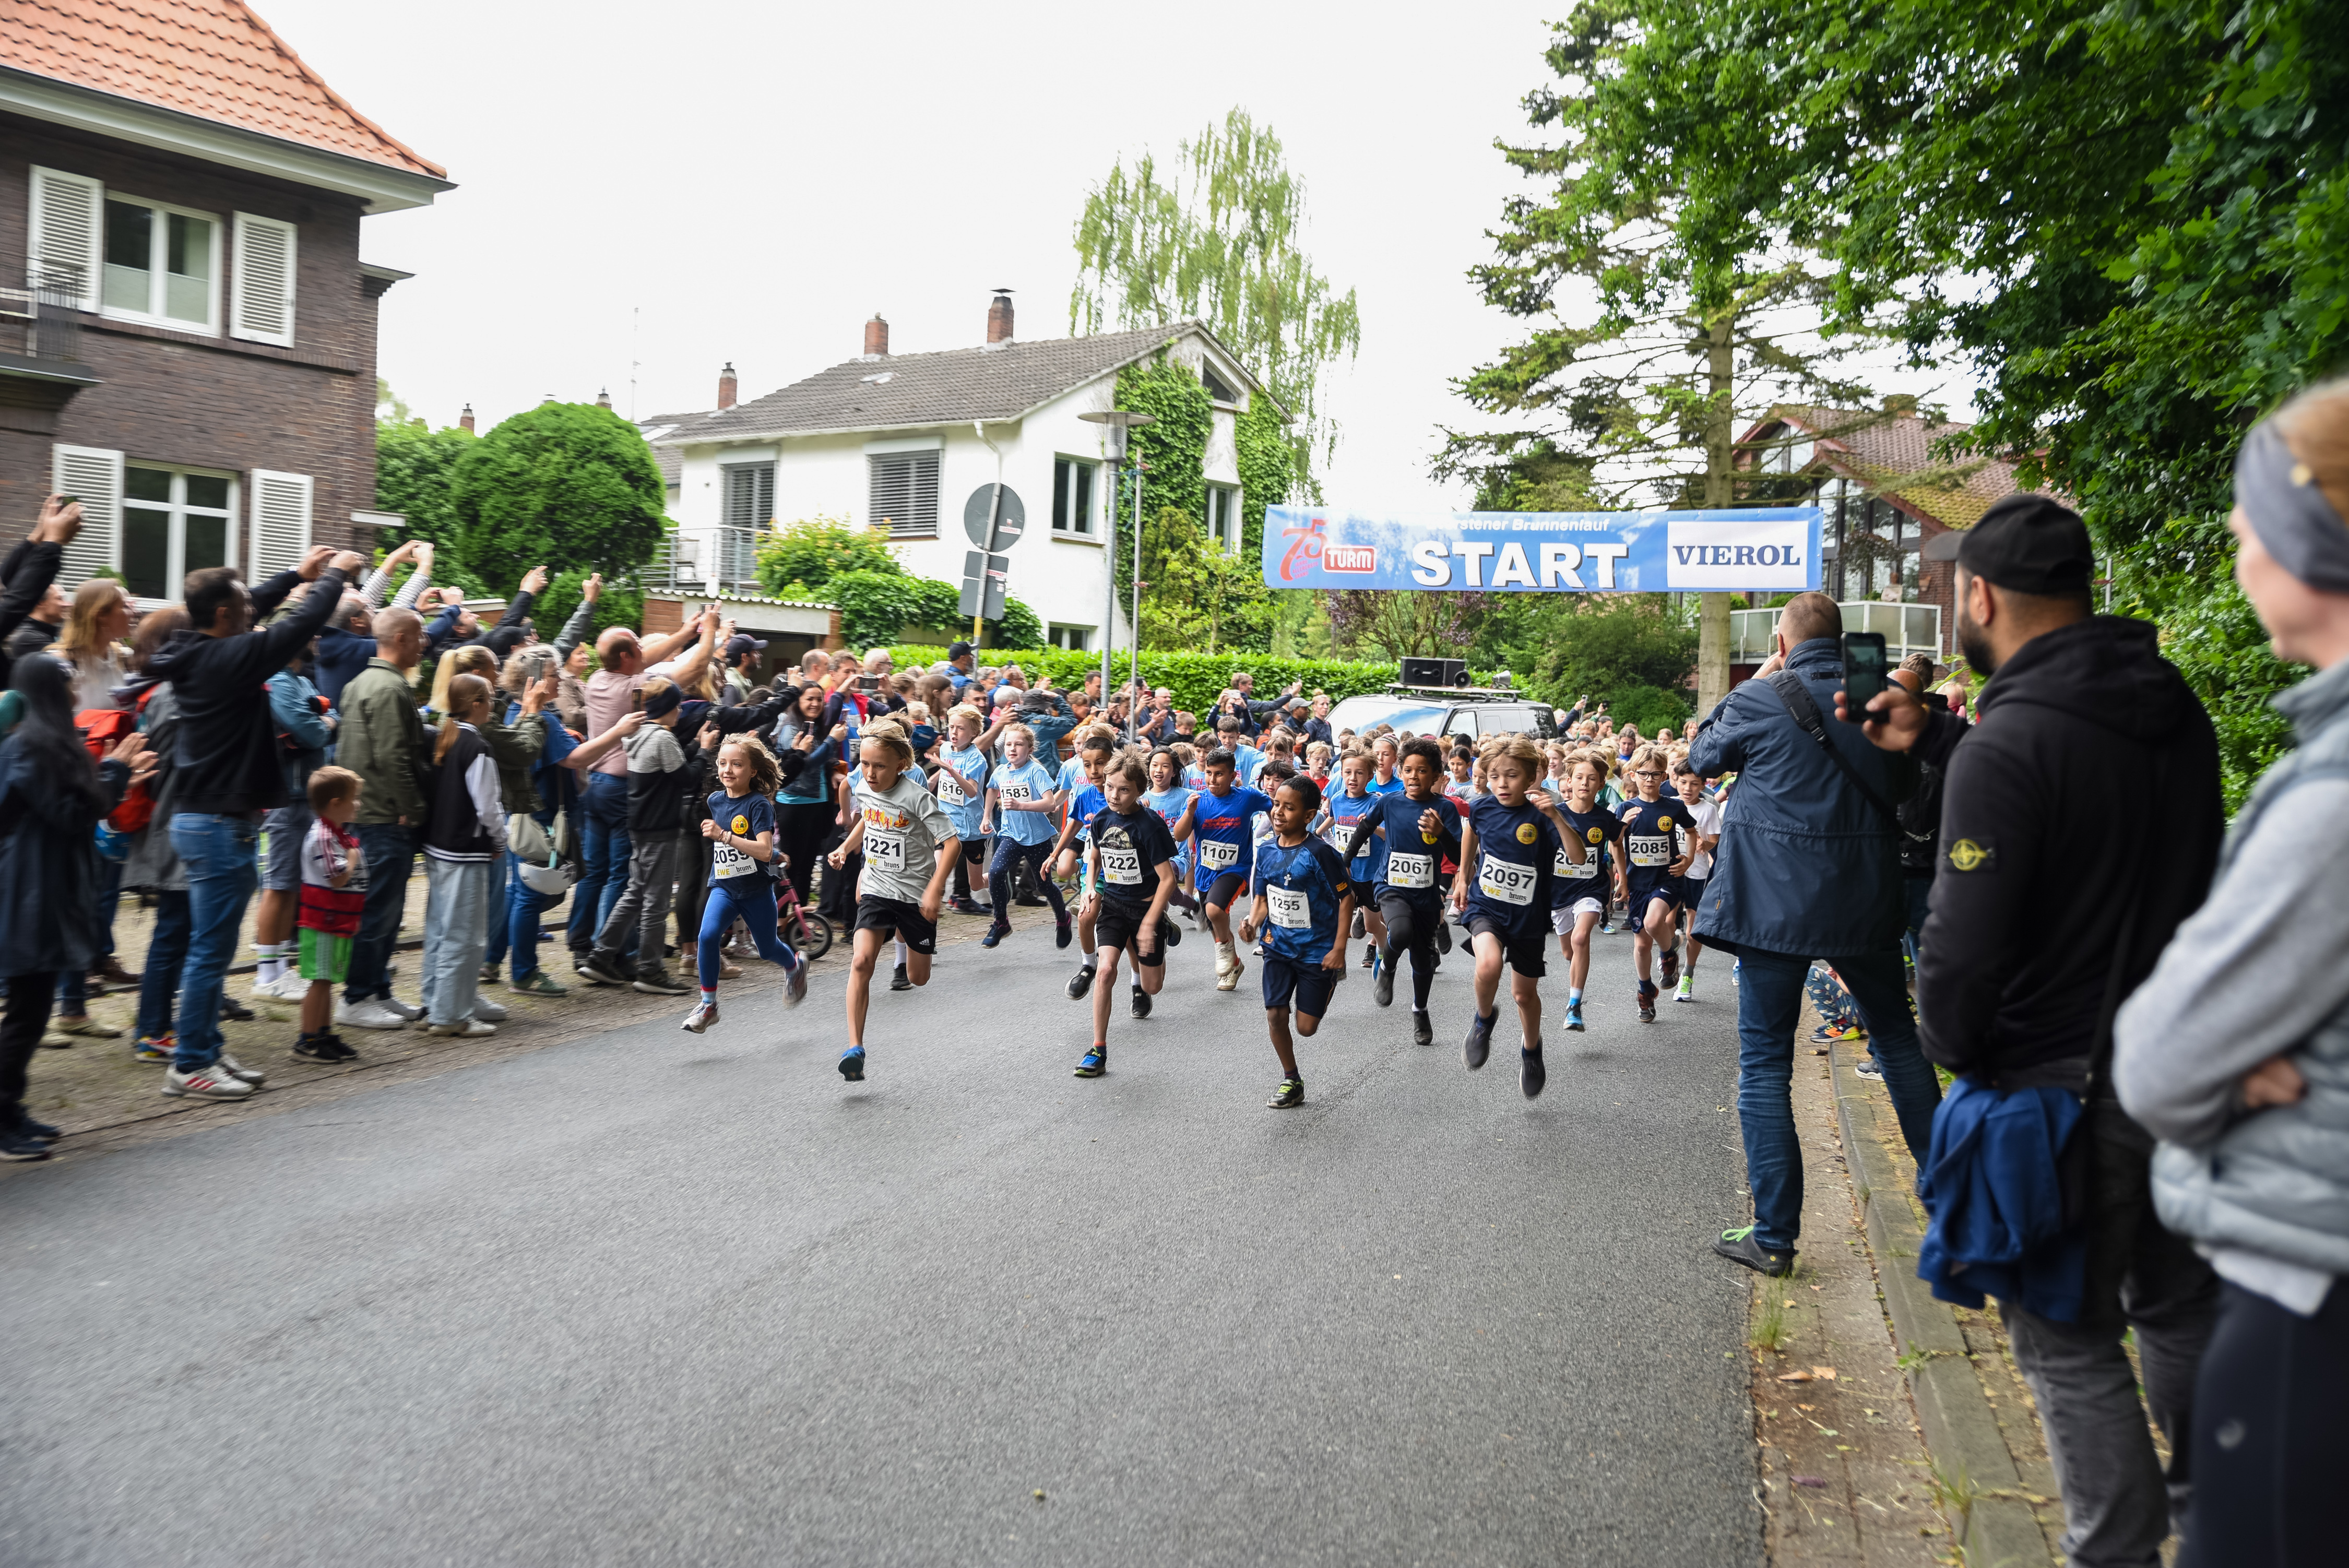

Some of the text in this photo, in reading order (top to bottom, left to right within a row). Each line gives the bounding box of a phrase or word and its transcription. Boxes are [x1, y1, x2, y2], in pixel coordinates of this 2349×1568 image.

[1512, 518, 1610, 531] Brunnenlauf
[1327, 551, 1372, 568] TURM
[1672, 545, 1800, 566] VIEROL
[1411, 541, 1628, 588] START
[940, 780, 963, 795] 1616
[1001, 787, 1029, 798] 1583
[864, 836, 900, 857] 1221
[1202, 846, 1237, 861] 1107
[1630, 842, 1668, 853] 2085
[866, 857, 900, 869] WE bruns
[1102, 855, 1138, 870] 1222
[1390, 859, 1432, 874] 2067
[1482, 864, 1534, 889] 2097
[1482, 884, 1502, 896] EWE
[1509, 892, 1528, 901] bruns
[1272, 896, 1300, 911] 1255
